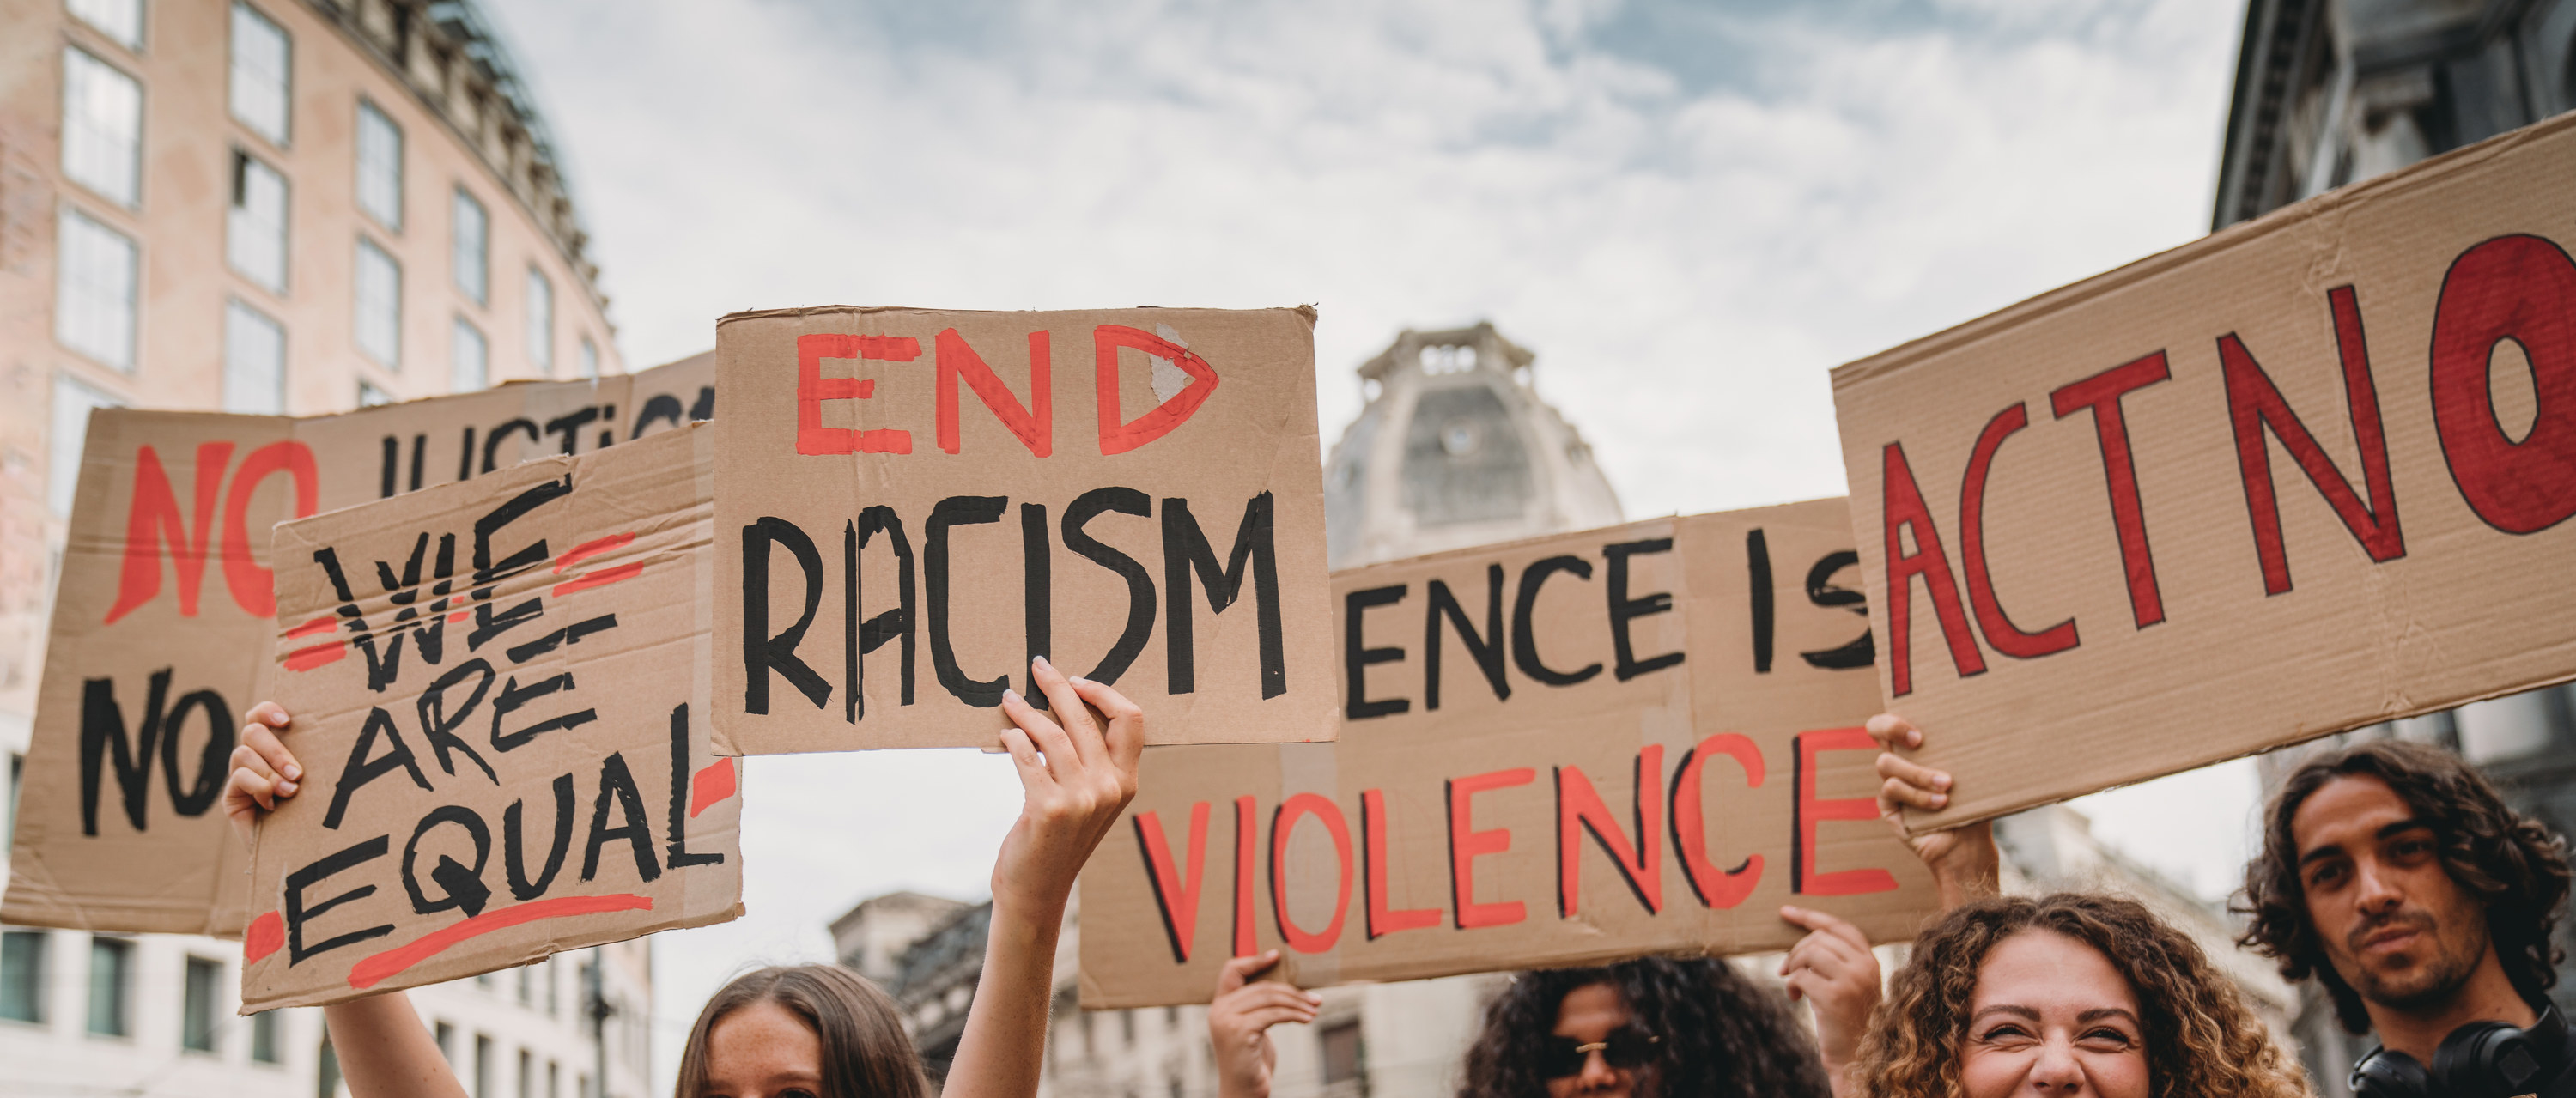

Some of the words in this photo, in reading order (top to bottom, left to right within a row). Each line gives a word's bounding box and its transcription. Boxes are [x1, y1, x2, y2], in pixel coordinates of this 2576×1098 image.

[796, 324, 1220, 458] END
[1883, 348, 2172, 698] ACT
[2216, 233, 2576, 597] NO
[105, 440, 319, 625] NO
[313, 472, 572, 692] WE
[742, 486, 1287, 725] RACISM
[1345, 537, 1686, 719] ENCE
[1747, 527, 1876, 674] IS
[80, 665, 235, 838] NO
[323, 613, 618, 830] ARE
[285, 701, 725, 968] EQUAL
[1133, 725, 1899, 964] VIOLENCE
